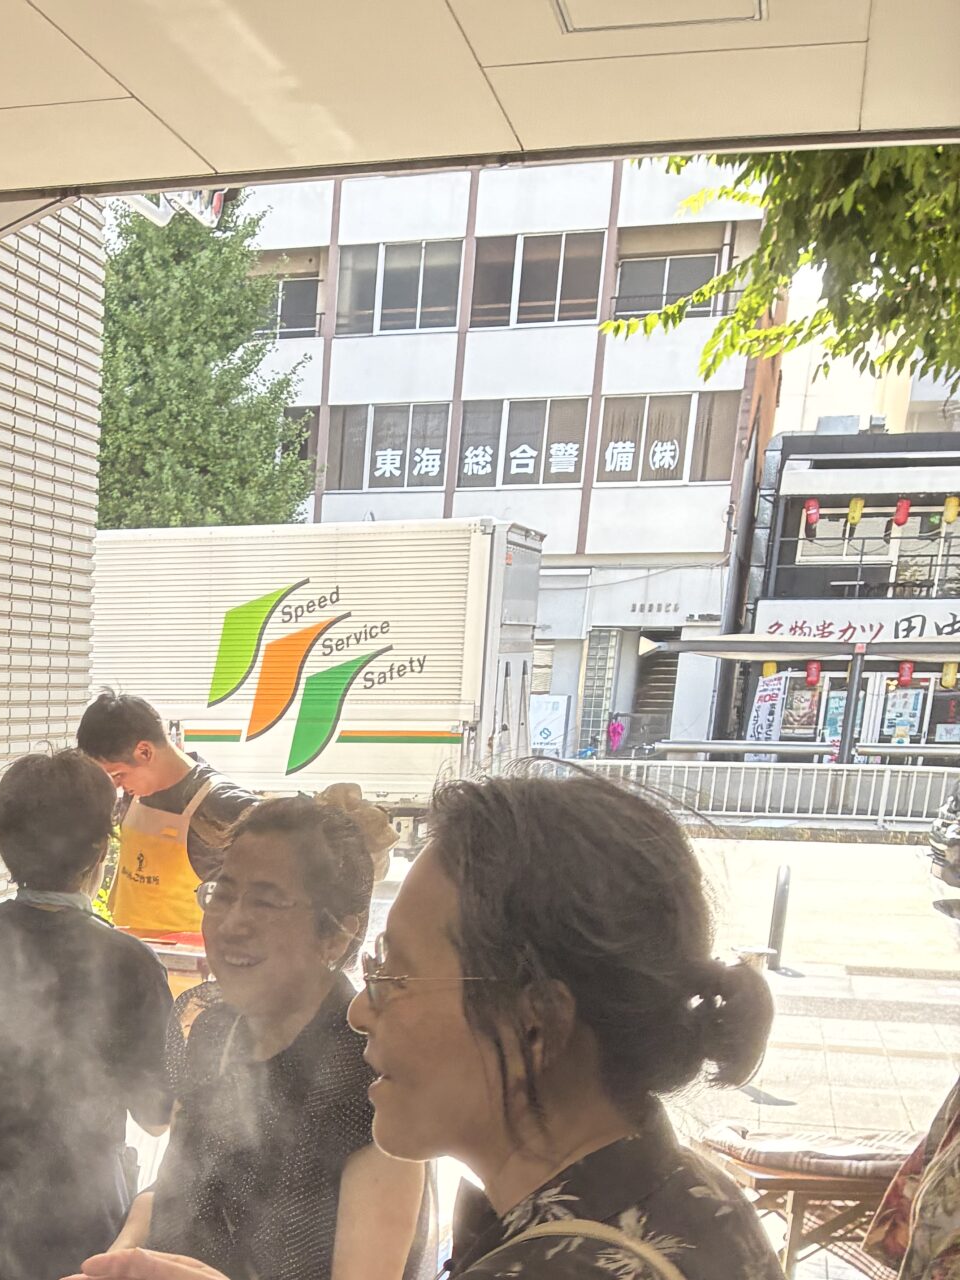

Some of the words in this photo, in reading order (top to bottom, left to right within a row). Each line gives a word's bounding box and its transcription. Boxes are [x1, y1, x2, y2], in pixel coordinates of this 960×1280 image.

[281, 587, 340, 624] Speed
[321, 621, 390, 657] Service
[362, 653, 427, 690] Safety
